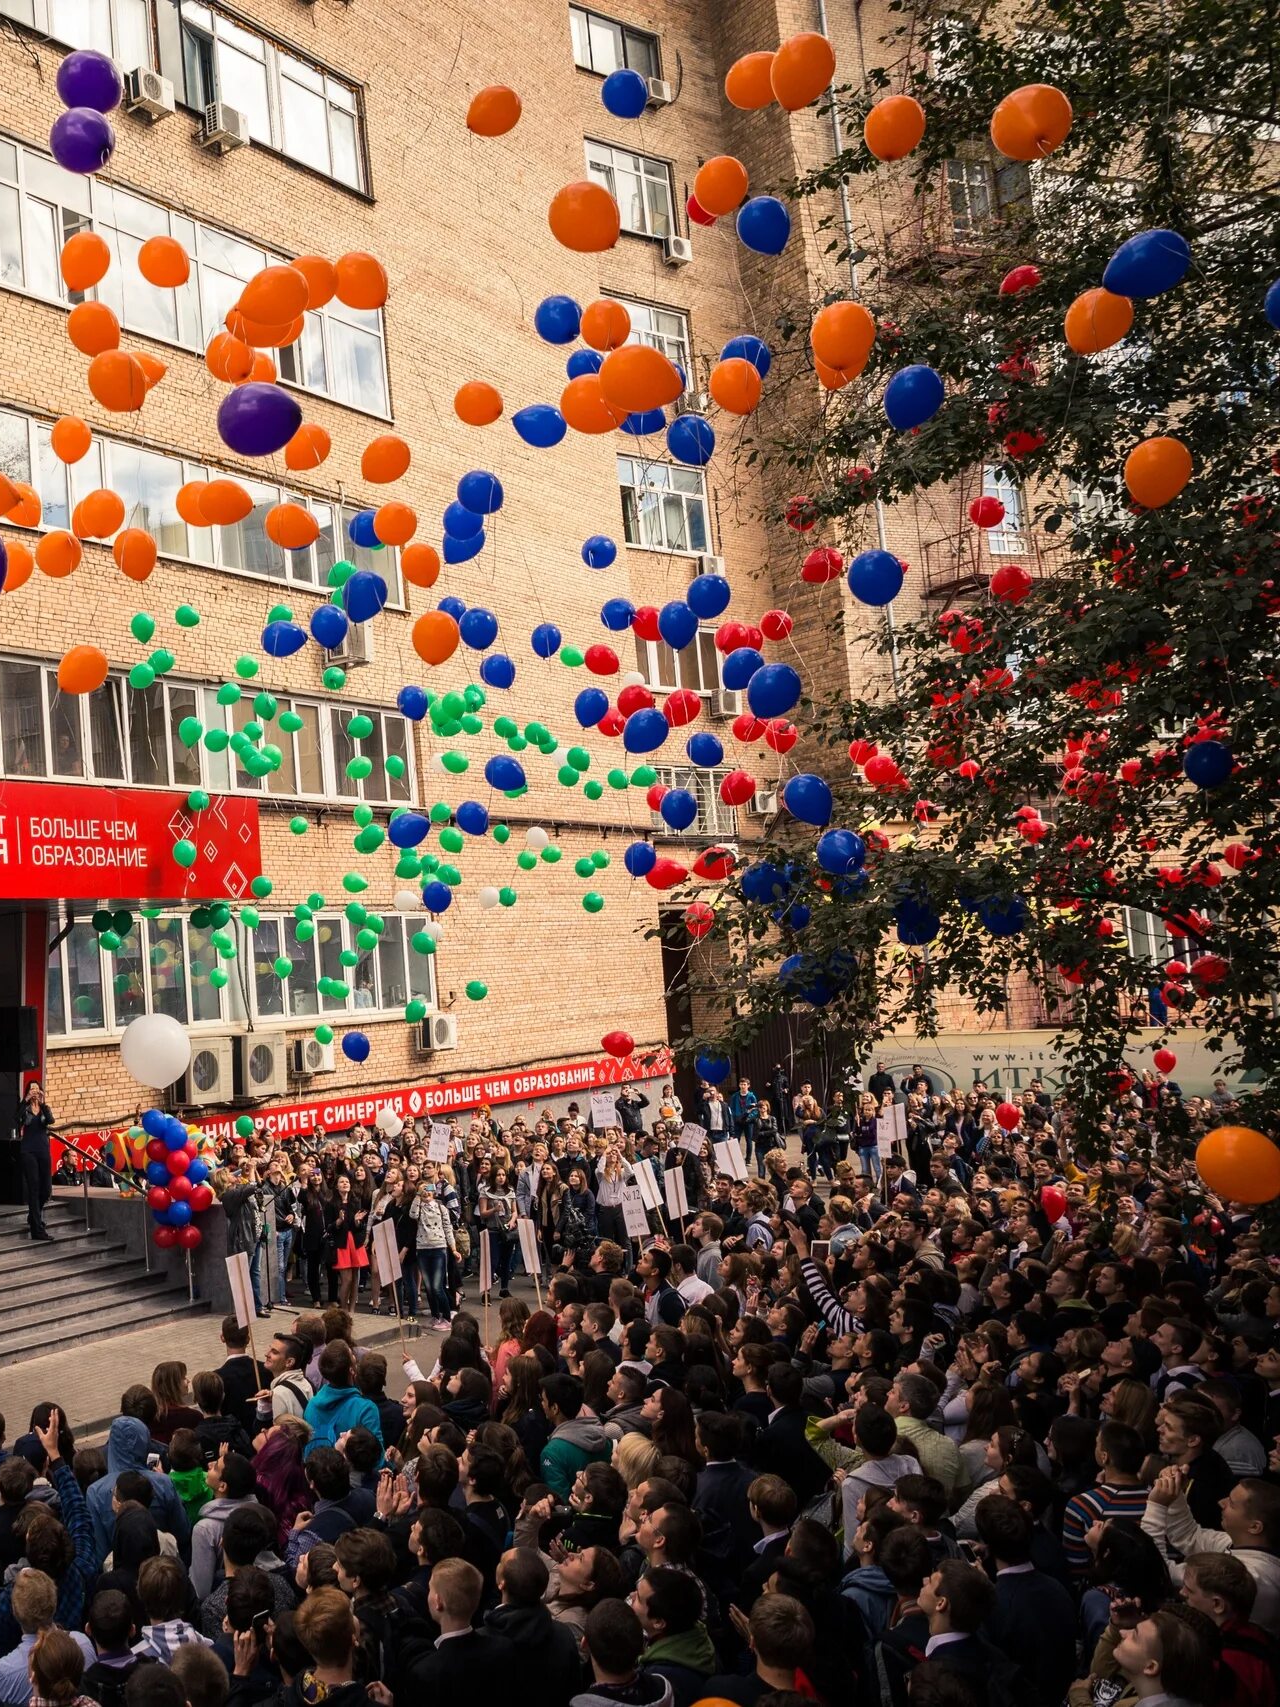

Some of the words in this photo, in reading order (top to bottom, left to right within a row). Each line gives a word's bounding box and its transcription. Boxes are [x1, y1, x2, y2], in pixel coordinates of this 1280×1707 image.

[29, 816, 100, 839] БОЛЬШЕ
[104, 820, 137, 841] ЧЕМ
[31, 844, 148, 868] ОБРАЗОВАНИЕ
[425, 1085, 481, 1108] БОЛЬШЕ
[485, 1080, 510, 1098] ЧЕМ
[513, 1067, 596, 1094] ОБРАЗОВАНИЕ
